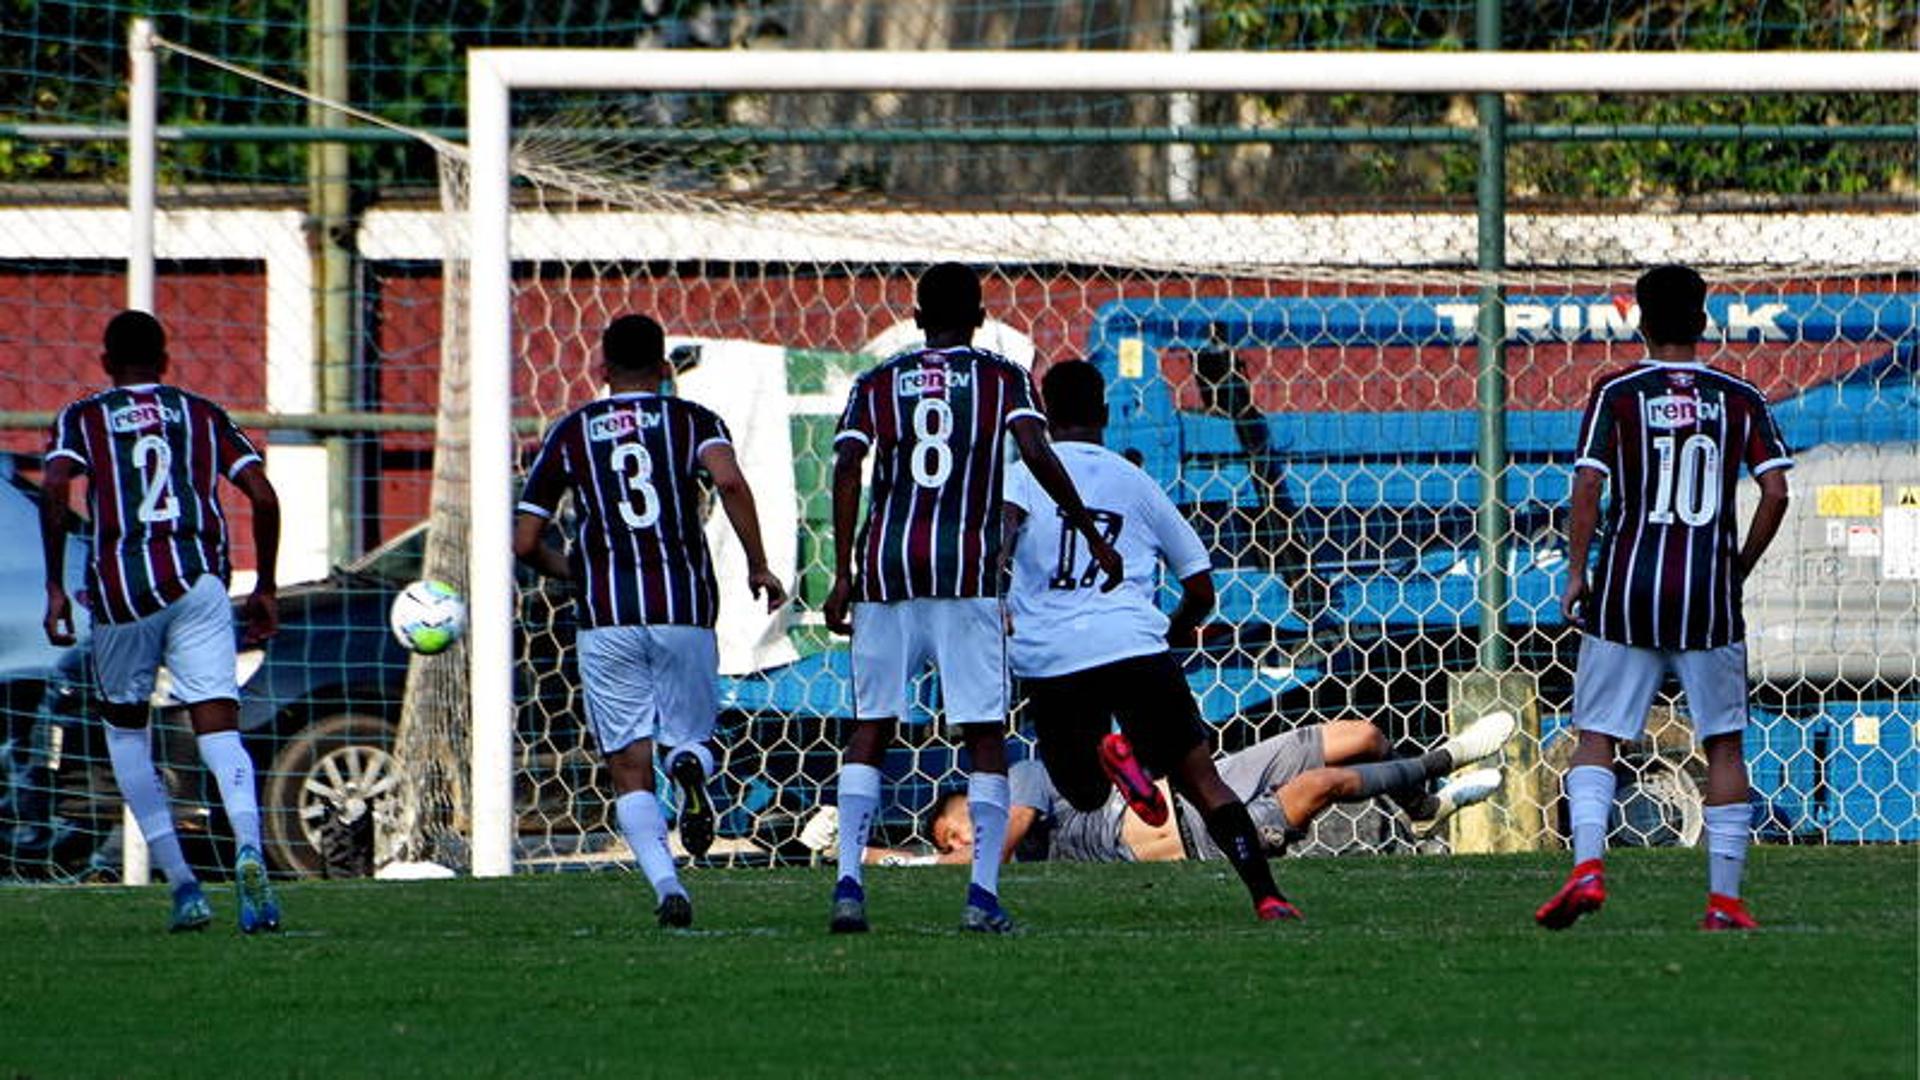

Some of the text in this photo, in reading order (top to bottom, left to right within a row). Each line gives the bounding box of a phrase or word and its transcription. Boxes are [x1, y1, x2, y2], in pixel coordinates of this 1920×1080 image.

[1436, 303, 1788, 341] TRIMK
[132, 434, 181, 522] 2
[611, 442, 661, 528] 3
[911, 398, 953, 488] 8
[1648, 434, 1719, 526] 10
